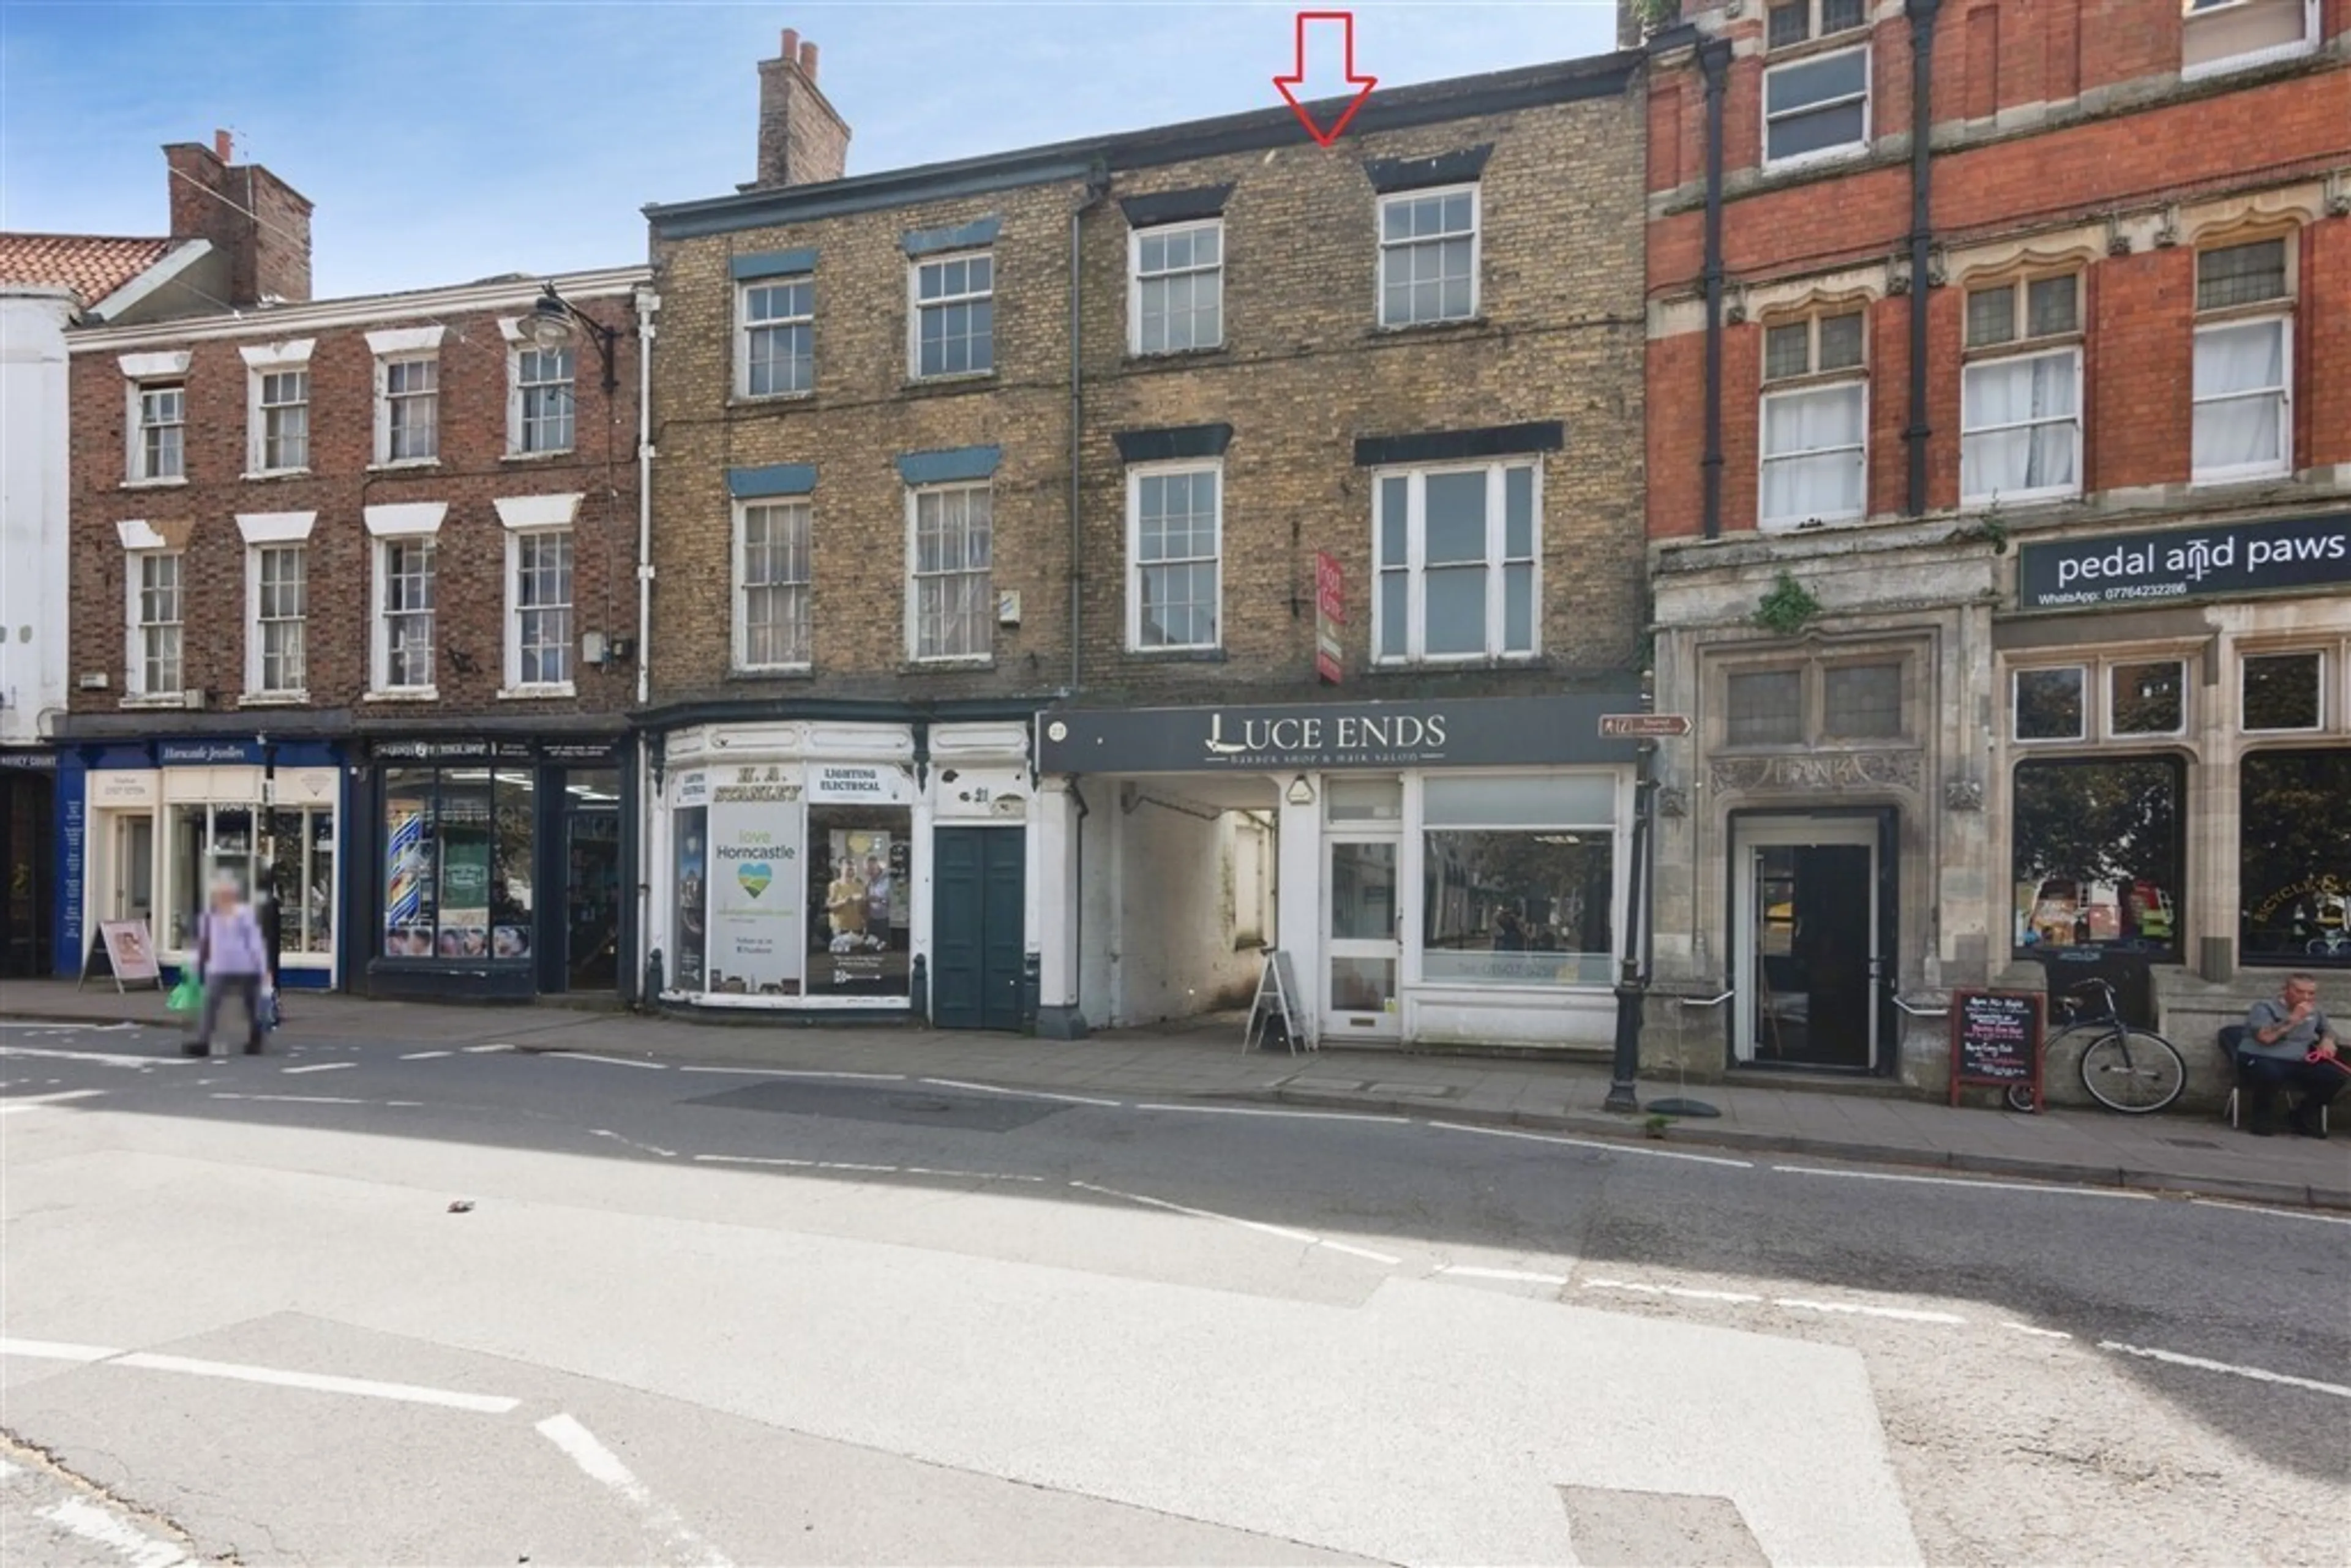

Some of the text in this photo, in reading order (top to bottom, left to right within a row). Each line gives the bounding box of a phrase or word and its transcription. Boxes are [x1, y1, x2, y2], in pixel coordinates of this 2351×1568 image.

[2058, 535, 2346, 588] pedal and paws
[2038, 590, 2101, 606] WhatsApp:
[1205, 713, 1446, 753] LUCE ENDS
[824, 769, 876, 779] LIGHTING
[820, 781, 880, 791] ELECTRICAL
[738, 829, 771, 844] love
[716, 845, 795, 859] Horncastle
